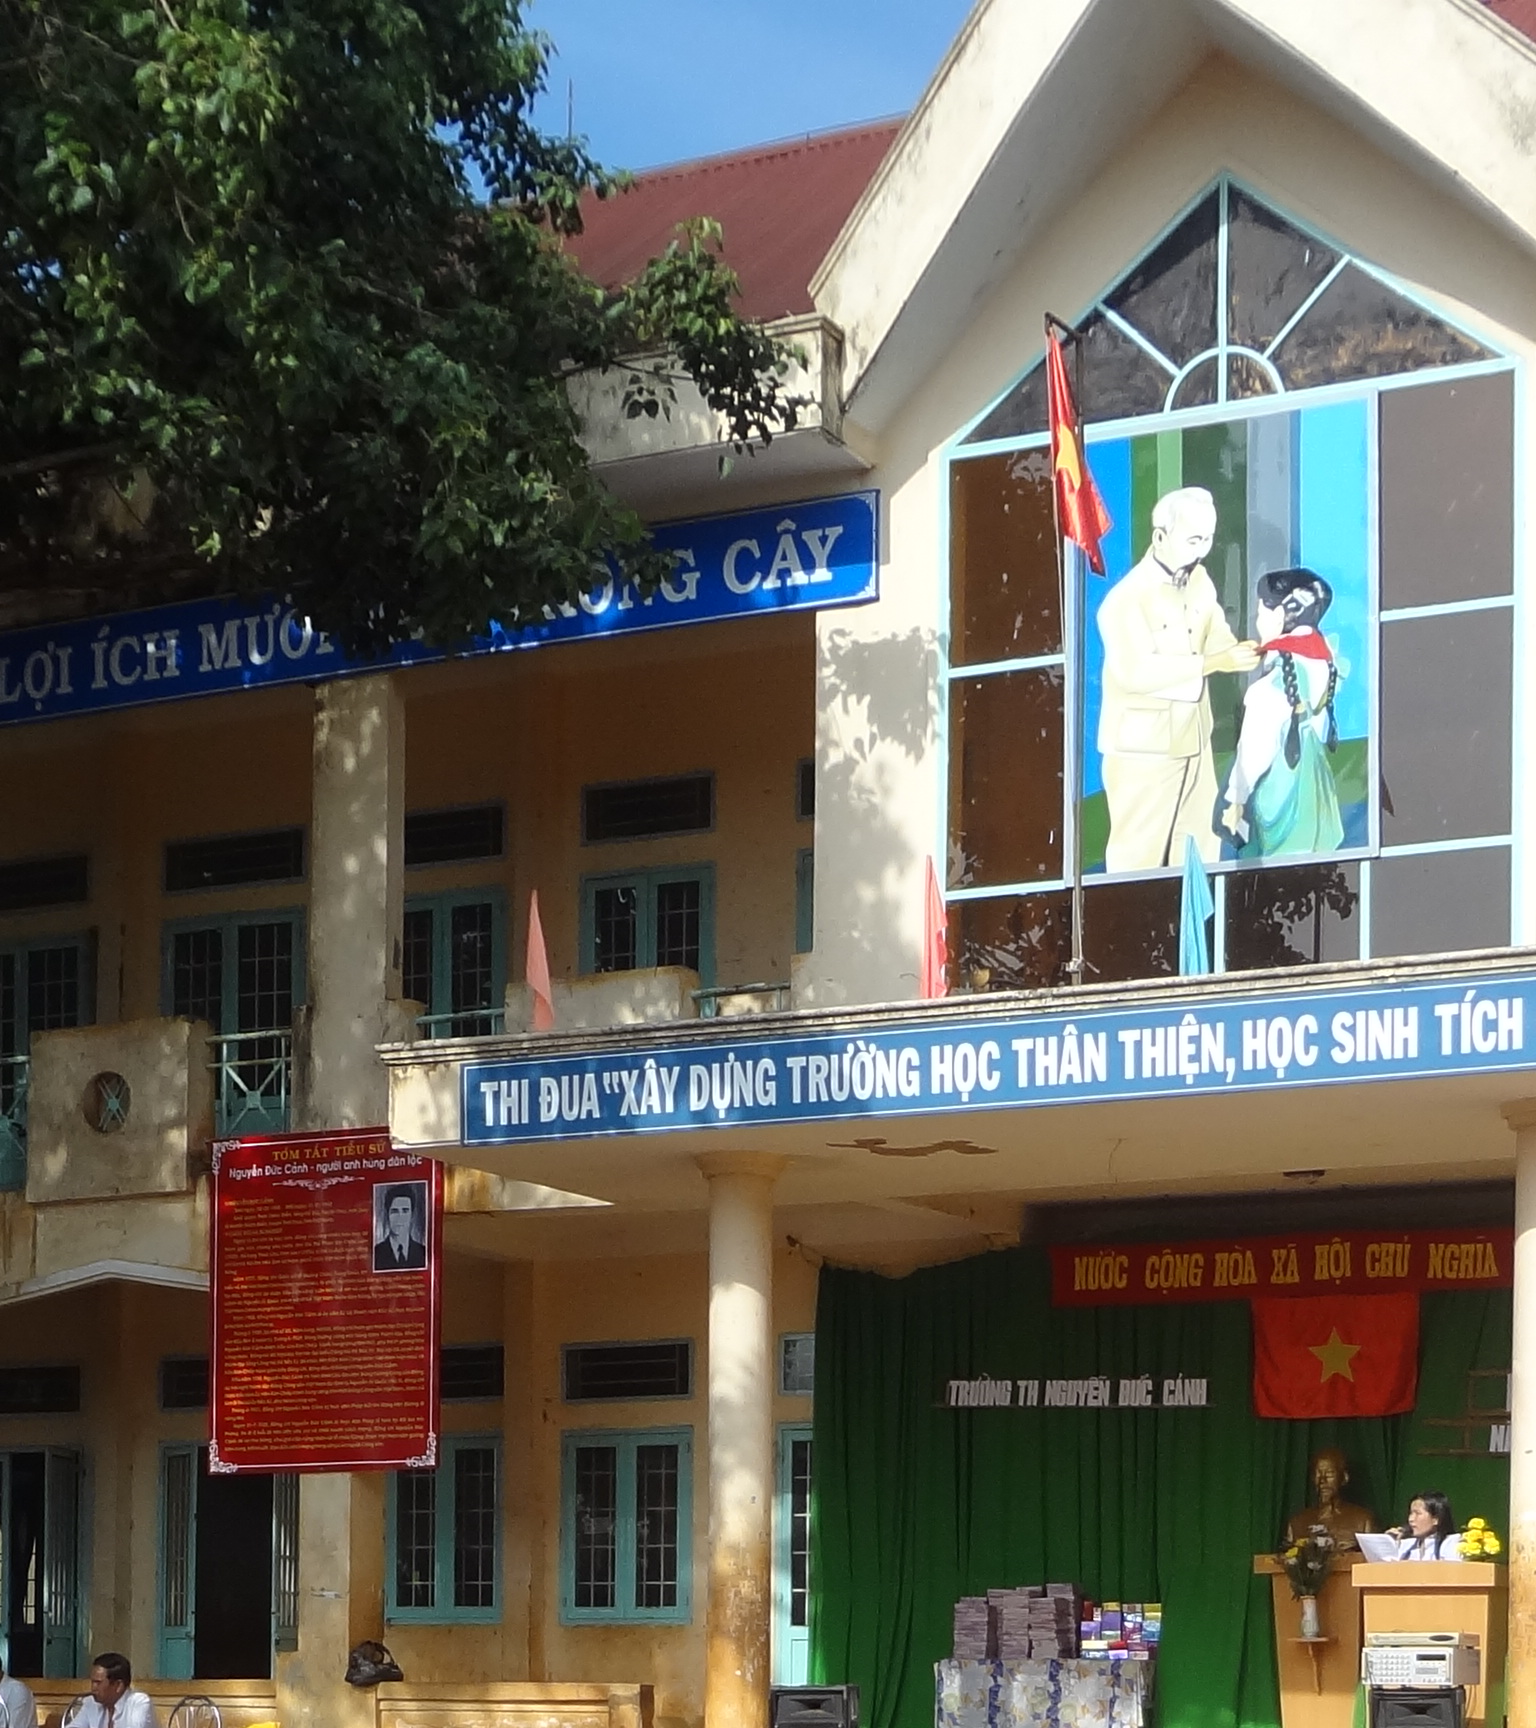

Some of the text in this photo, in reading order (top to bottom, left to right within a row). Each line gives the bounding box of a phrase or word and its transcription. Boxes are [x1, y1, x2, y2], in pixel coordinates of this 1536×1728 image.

[91, 625, 180, 689] ÍCH
[722, 518, 843, 595] CÂY
[480, 1078, 529, 1127] THI
[539, 1073, 600, 1120] ĐUA
[689, 1051, 776, 1118] DỰNG
[787, 1042, 920, 1104] TRƯỜNG
[930, 1041, 1001, 1102] HỌC
[1011, 1024, 1107, 1088] THÂN
[1118, 1013, 1236, 1084] THIỆN,
[1242, 1015, 1318, 1078] HỌC
[1330, 1007, 1418, 1065] SINH
[1433, 990, 1523, 1056] TÍCH
[229, 1164, 263, 1180] Nguyễn
[265, 1166, 282, 1176] Đức
[284, 1162, 308, 1174] Cảnh
[344, 1160, 361, 1169] anh
[1145, 1249, 1205, 1294] CỘNG
[1213, 1245, 1258, 1287] HÒA
[1270, 1243, 1300, 1285] XÃ
[1315, 1237, 1352, 1285] HỘI
[1427, 1236, 1499, 1279] NGHĨA
[948, 1372, 1012, 1406] TRƯỜNG
[1017, 1380, 1039, 1406] TH
[1044, 1375, 1111, 1406] NGUYỄN
